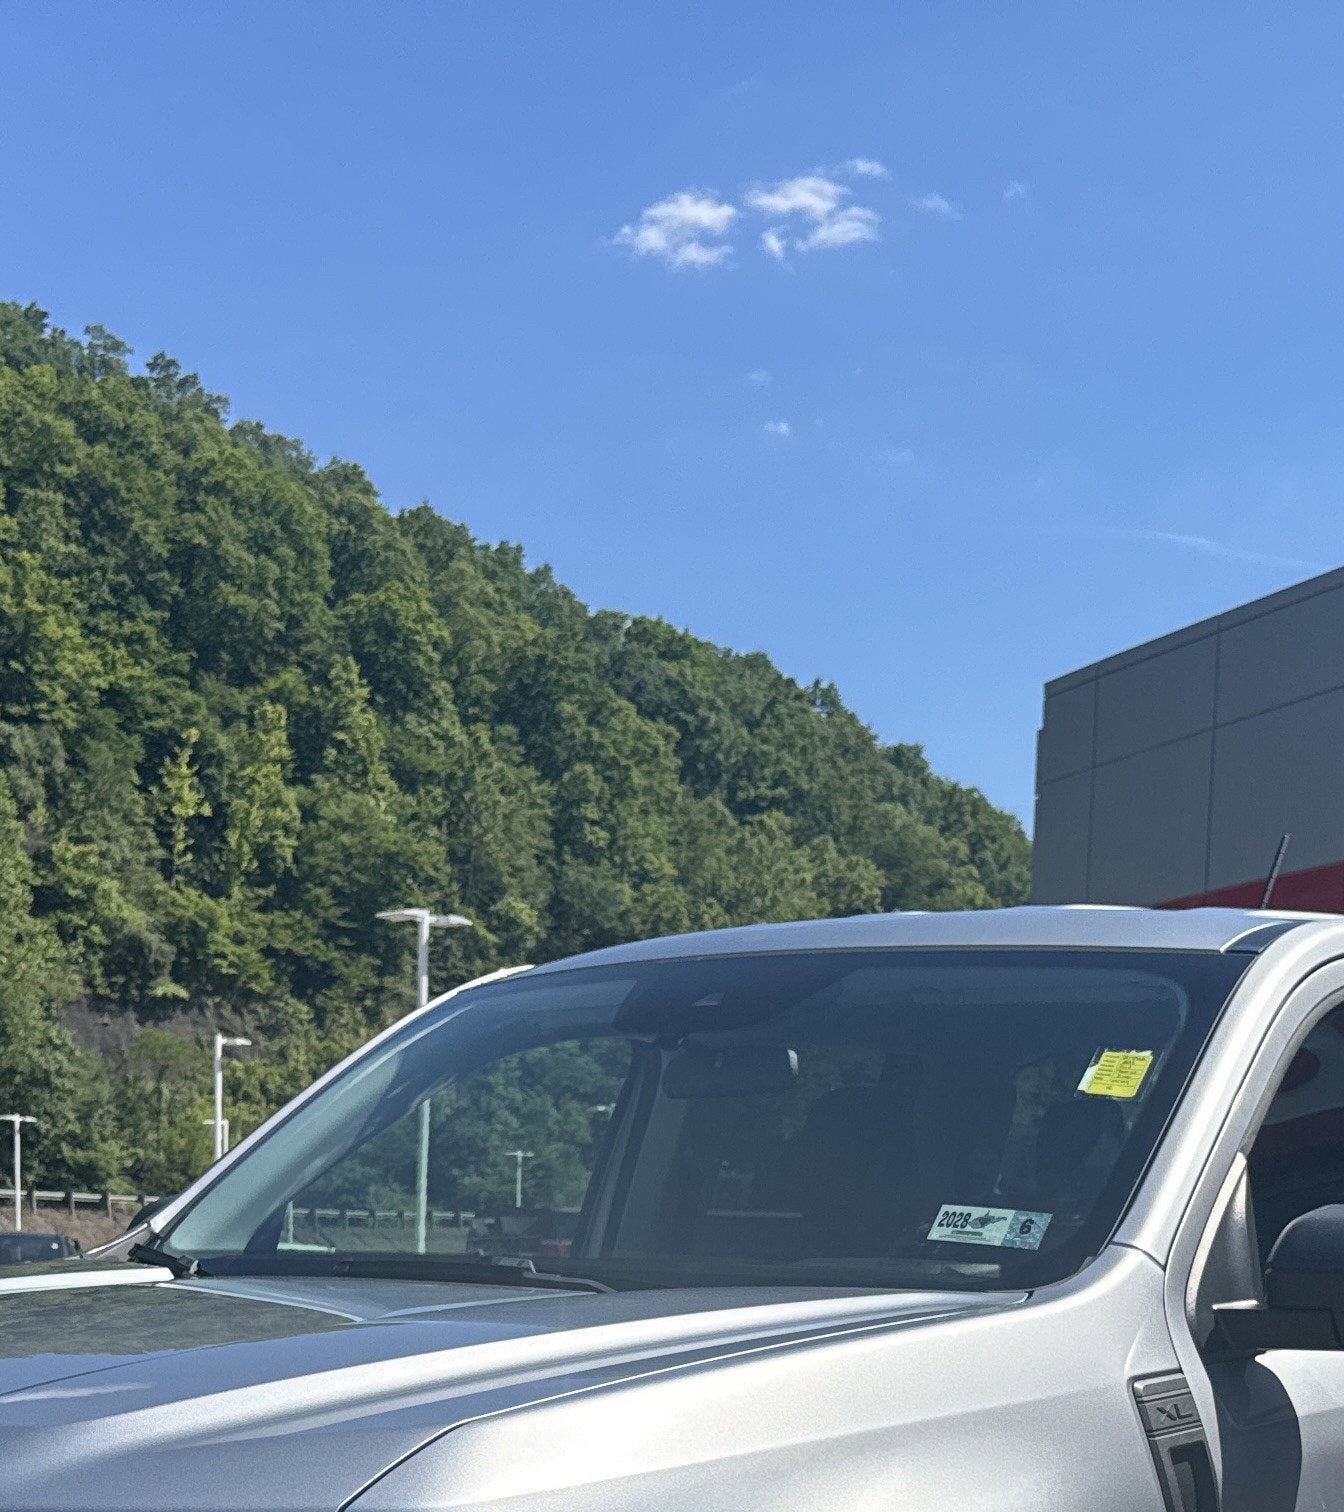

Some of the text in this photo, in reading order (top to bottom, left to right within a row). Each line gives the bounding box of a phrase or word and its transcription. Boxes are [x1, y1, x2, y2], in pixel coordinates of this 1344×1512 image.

[937, 1210, 972, 1229] 2028
[1019, 1217, 1035, 1235] 6
[1156, 1403, 1193, 1421] XL
